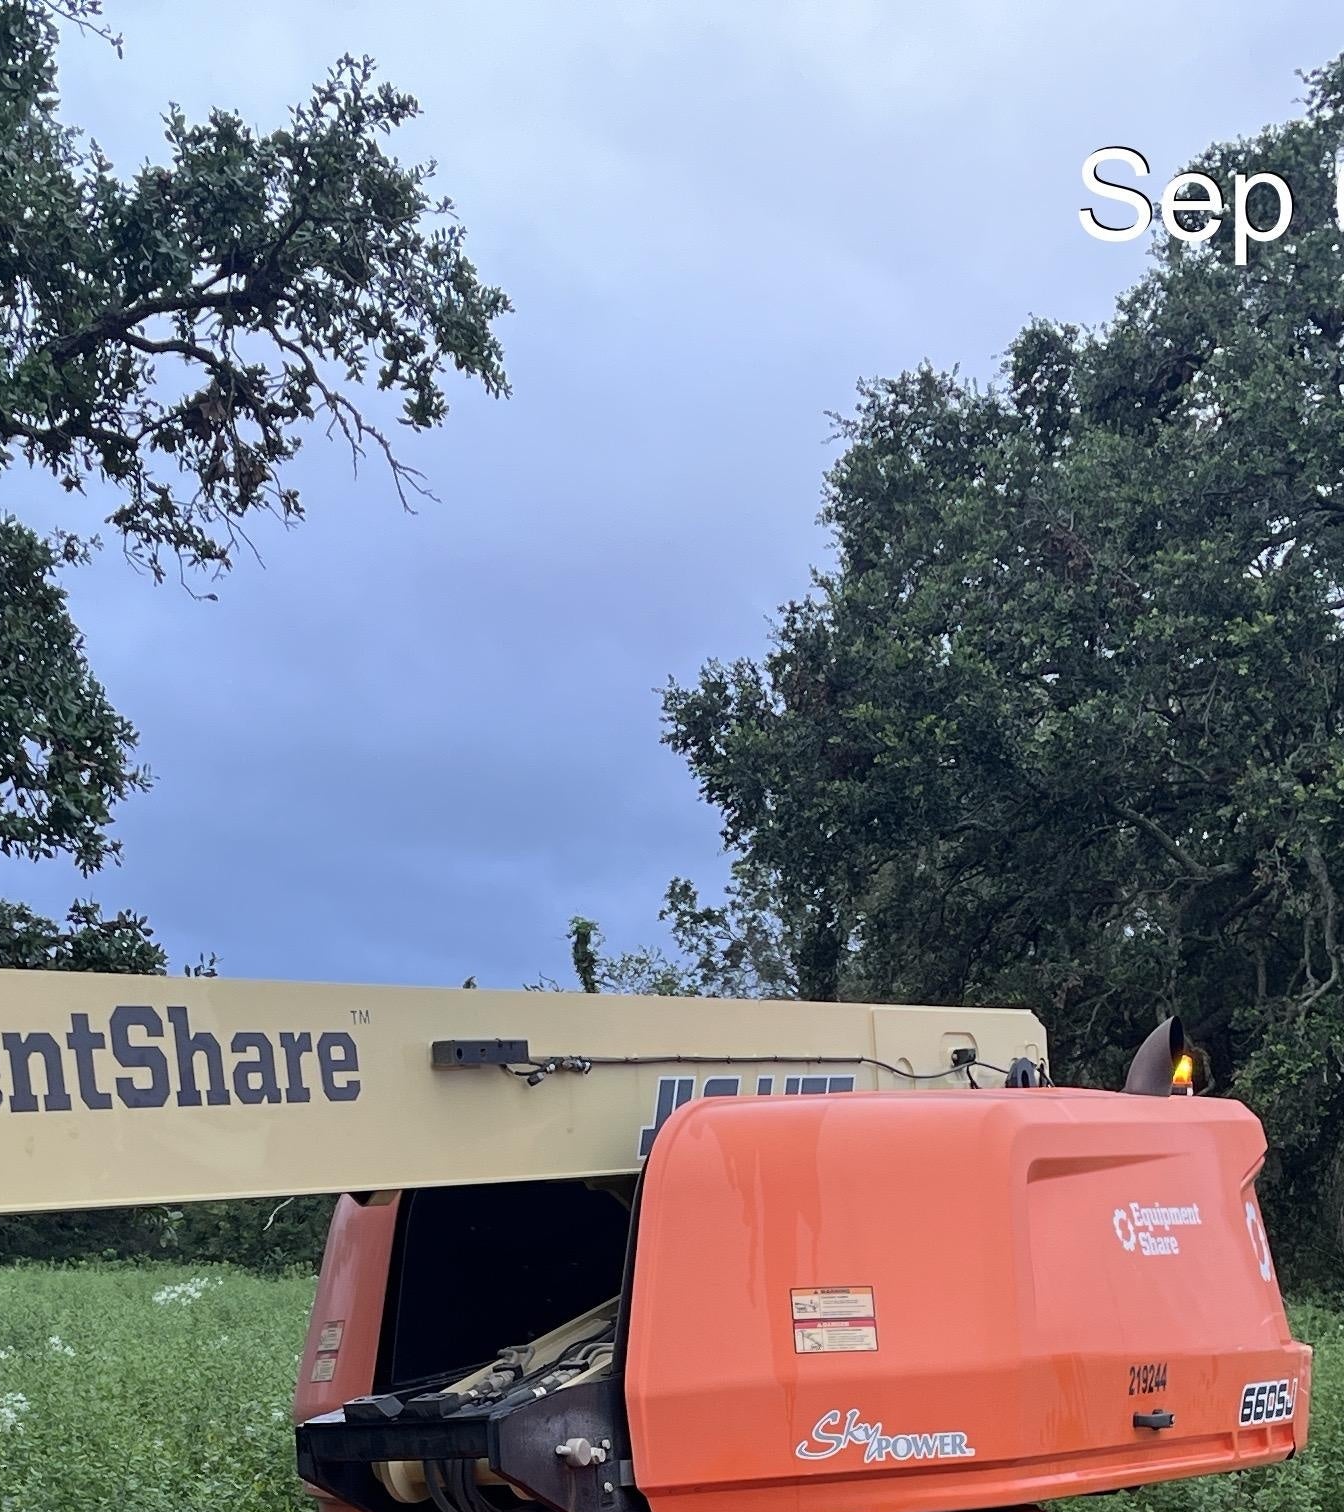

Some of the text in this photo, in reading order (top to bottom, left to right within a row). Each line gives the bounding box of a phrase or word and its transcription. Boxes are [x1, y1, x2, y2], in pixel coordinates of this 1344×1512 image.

[1129, 1202, 1202, 1231] Equipment
[1138, 1232, 1180, 1256] Share
[1128, 1362, 1168, 1396] 219244
